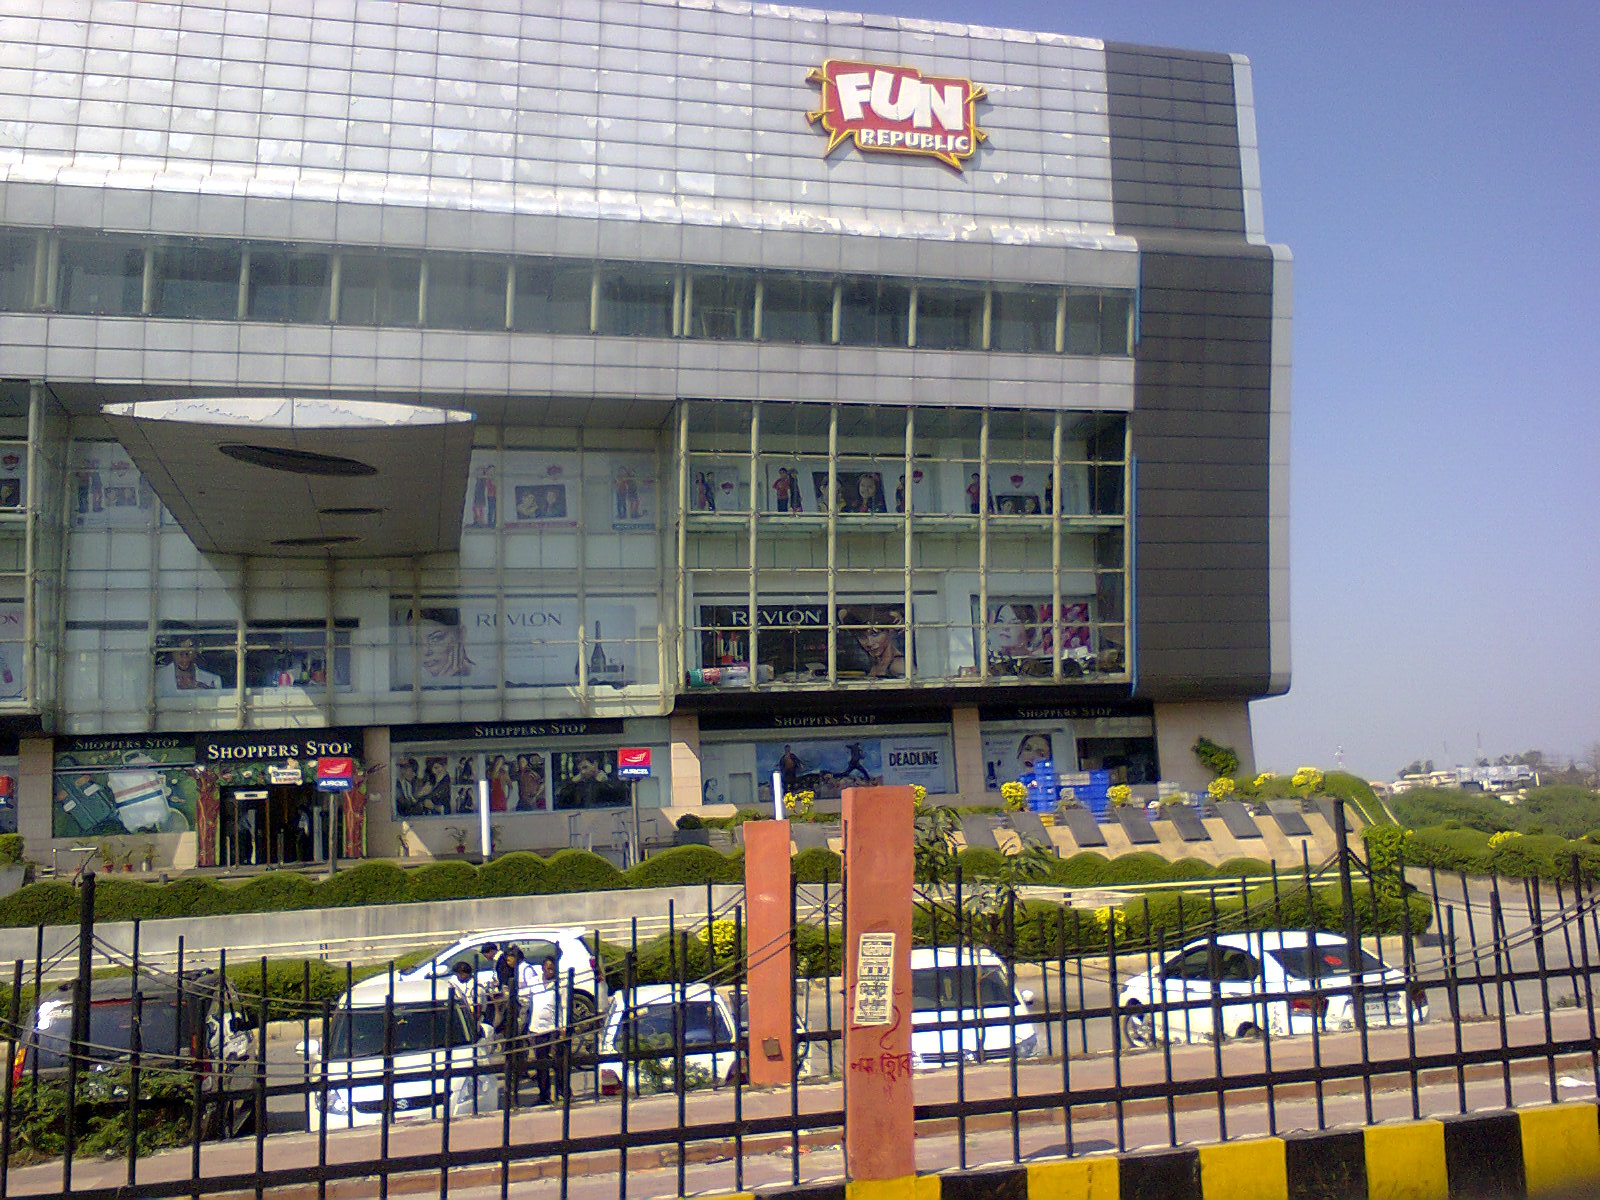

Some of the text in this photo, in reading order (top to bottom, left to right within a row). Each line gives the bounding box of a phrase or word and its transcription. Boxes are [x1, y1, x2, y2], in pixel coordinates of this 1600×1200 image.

[835, 69, 964, 131] FUN
[860, 128, 969, 150] REPUBLIC
[477, 611, 562, 626] RVLON
[732, 609, 820, 625] RVLON
[474, 722, 587, 737] SHOPPERS STOP
[207, 740, 352, 759] SHOPPERS STOP
[889, 751, 938, 767] DEADLINE
